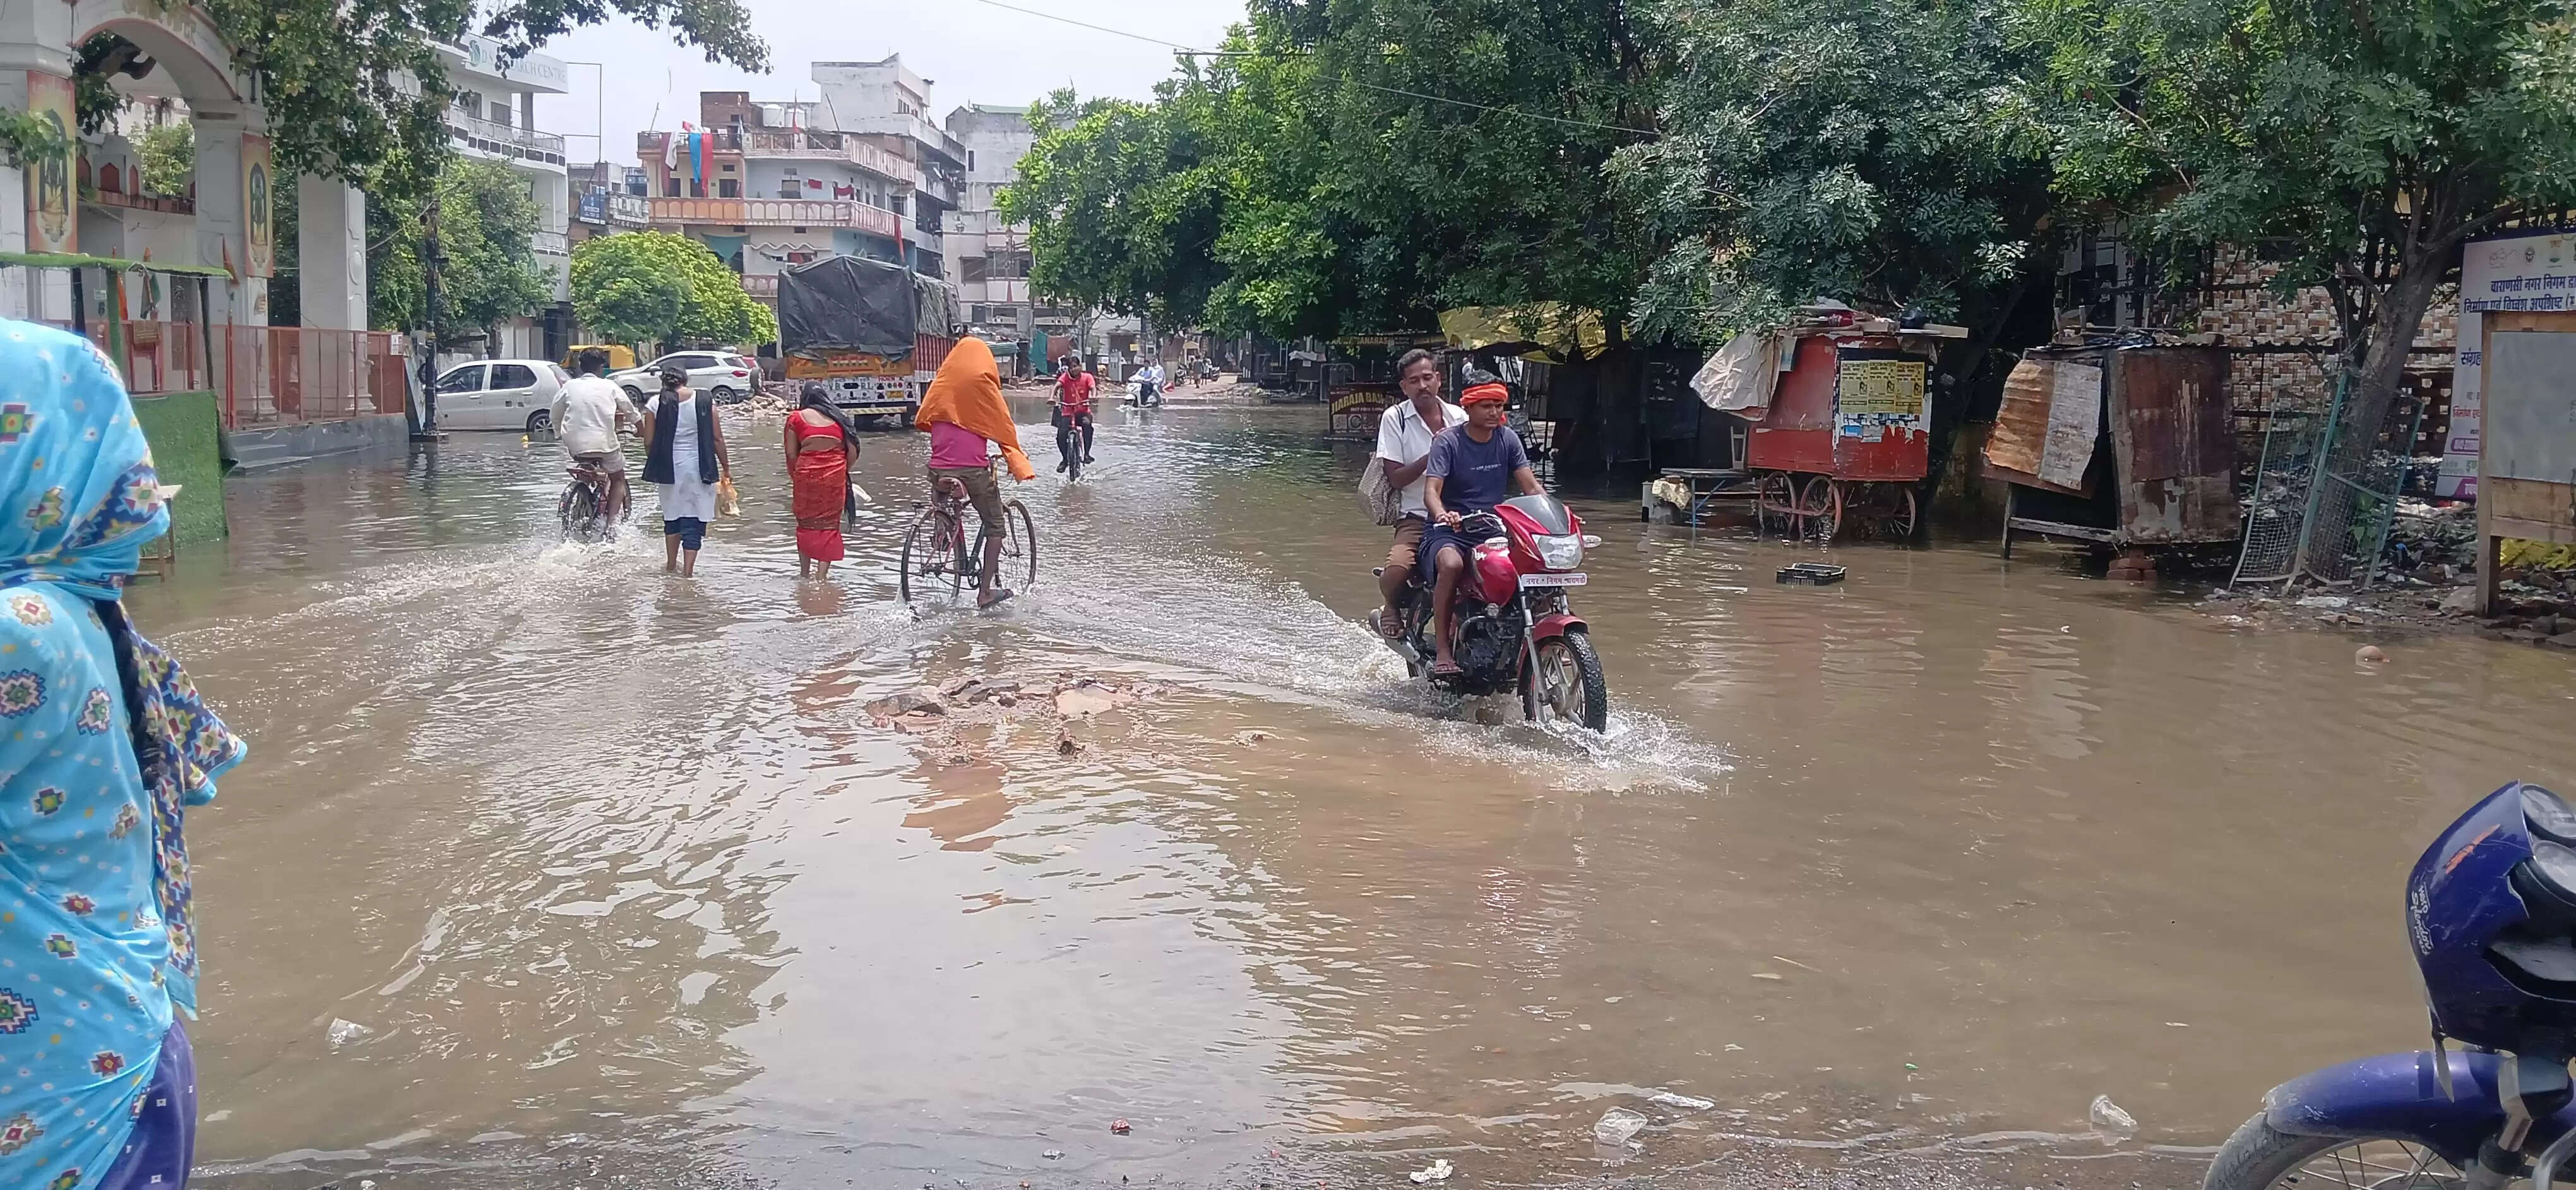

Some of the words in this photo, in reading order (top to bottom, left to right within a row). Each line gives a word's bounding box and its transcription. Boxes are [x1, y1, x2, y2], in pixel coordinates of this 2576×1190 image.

[538, 64, 566, 83] CENTRE
[2491, 275, 2523, 292] वाराणसी
[2525, 277, 2542, 291] नगर
[2544, 273, 2567, 290] निगम
[2530, 294, 2563, 310] अपशिष्ट
